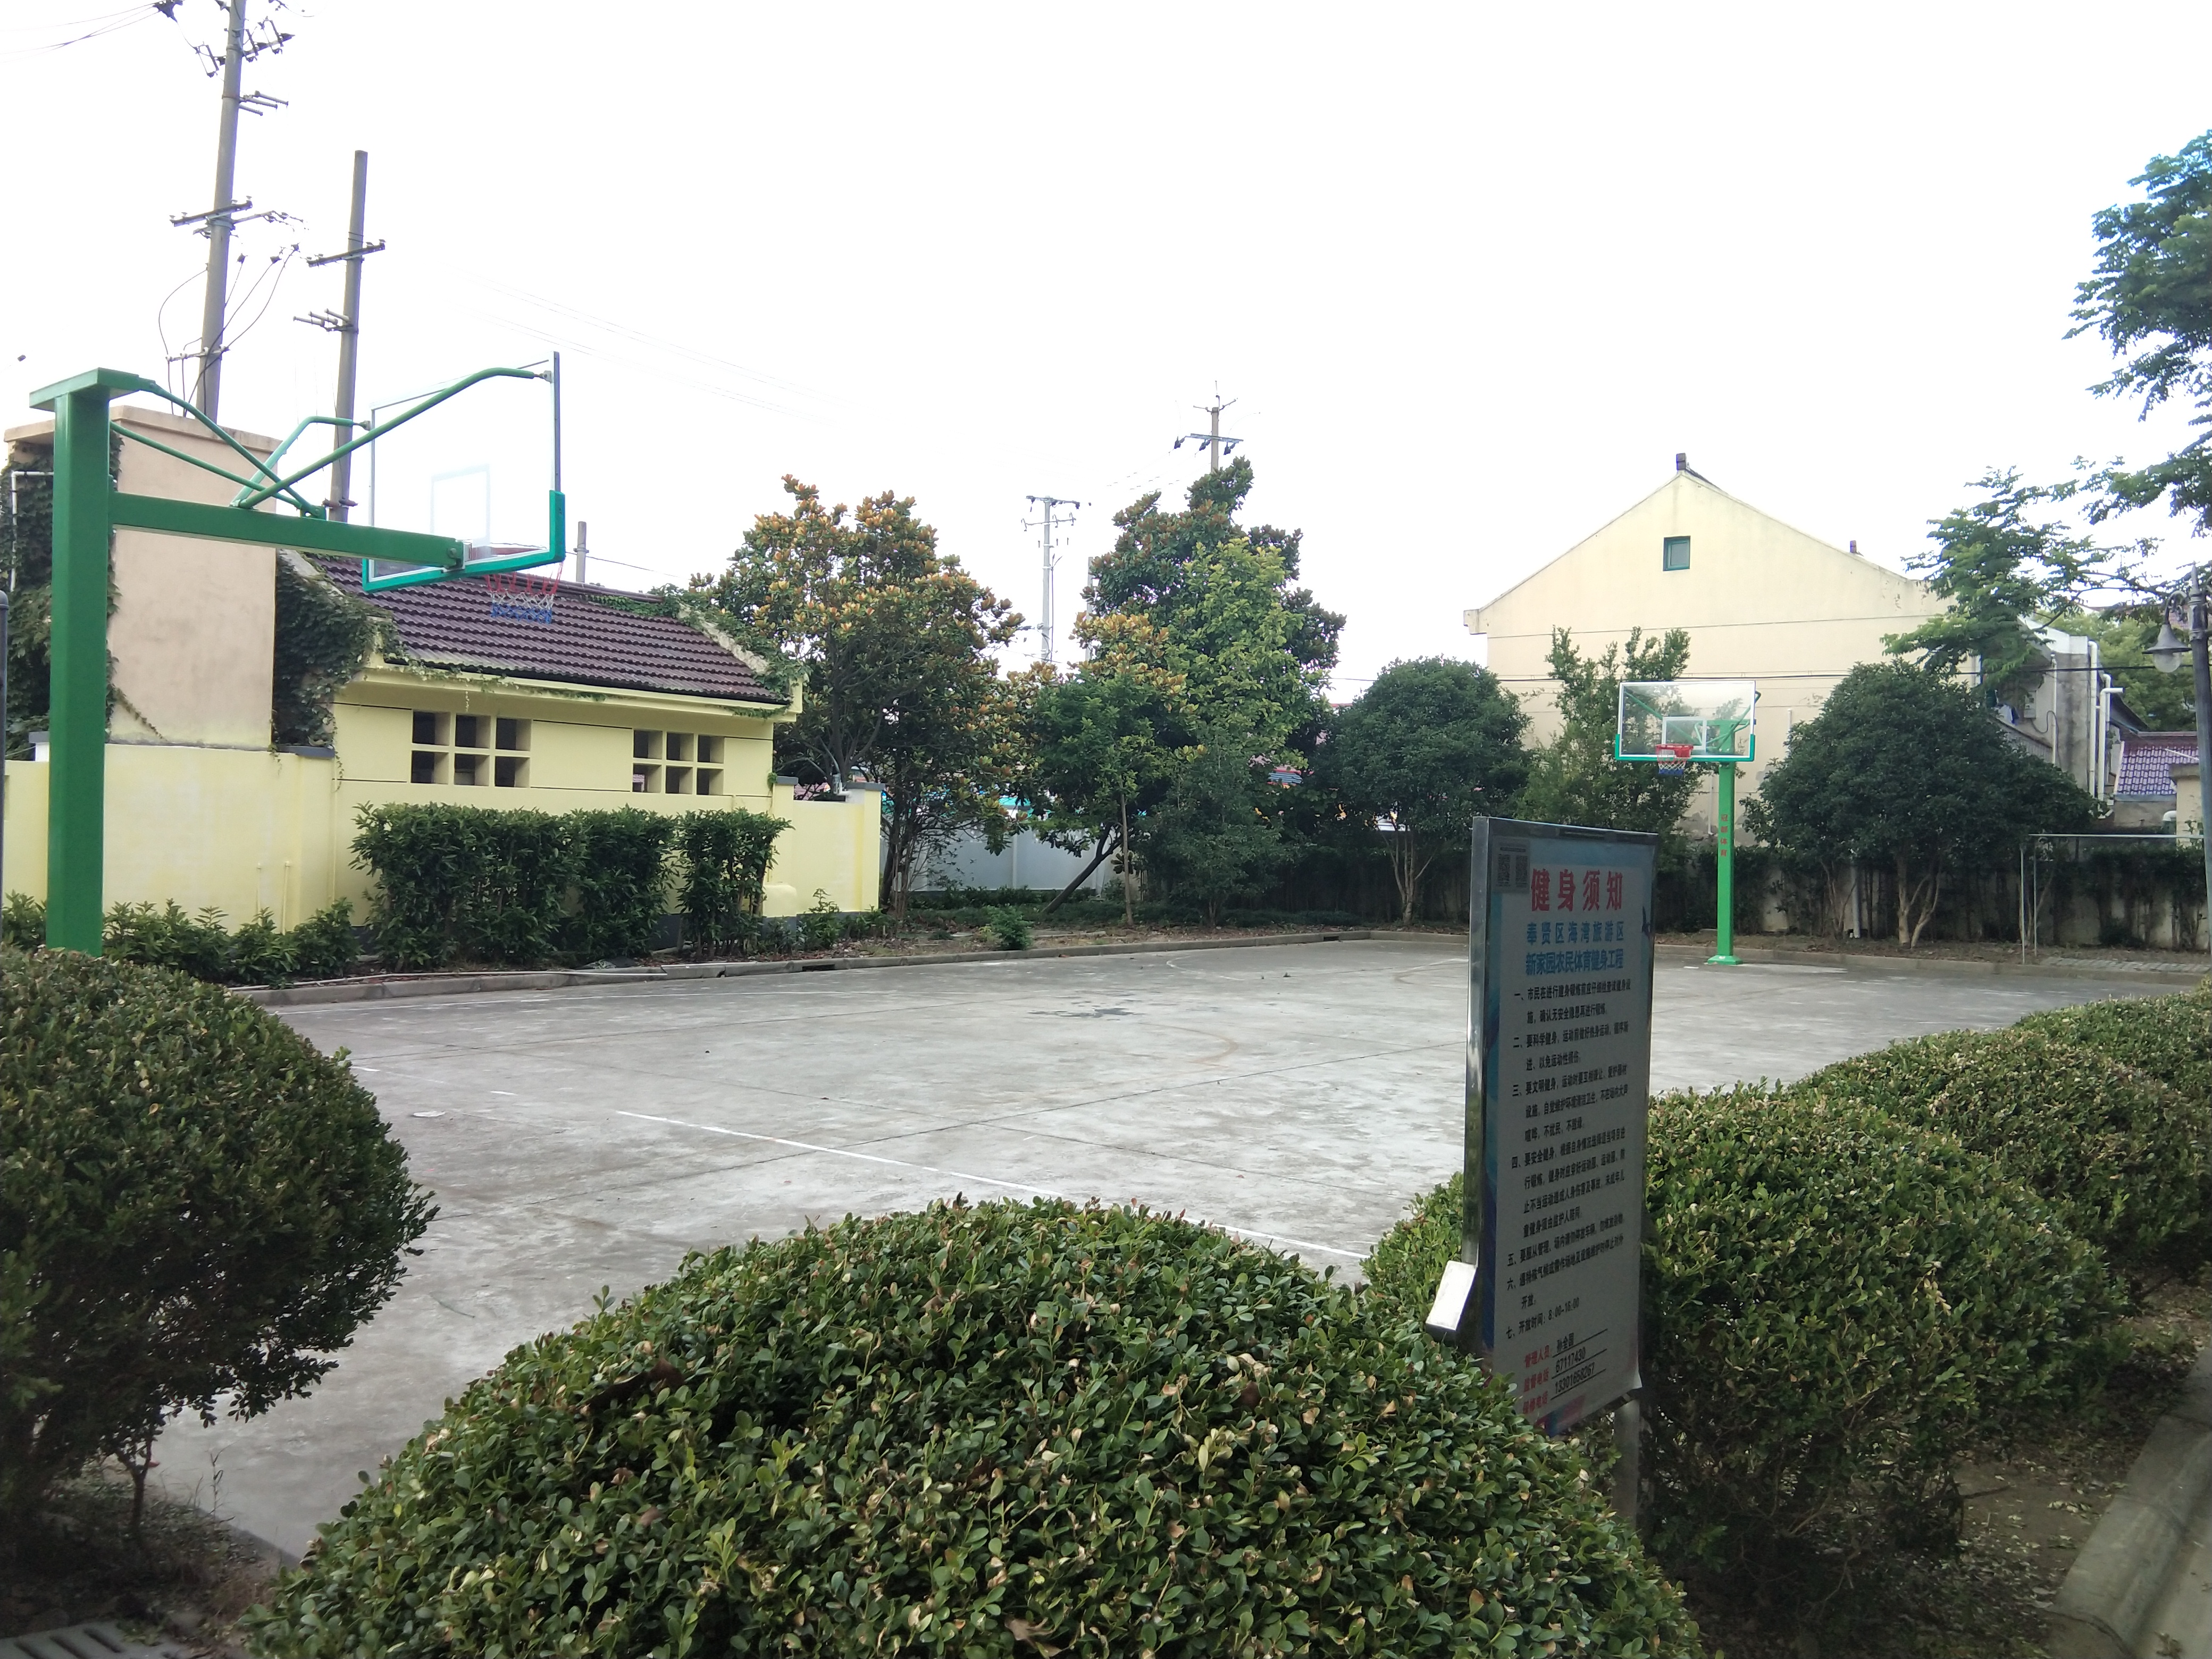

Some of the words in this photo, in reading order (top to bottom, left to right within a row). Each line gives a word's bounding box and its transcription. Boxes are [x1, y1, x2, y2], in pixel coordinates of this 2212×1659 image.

[1531, 868, 1623, 911] 健身须知
[1527, 920, 1624, 945] 奉贤区海湾旅游区
[1526, 949, 1623, 976] 新家园农民体育健身工程
